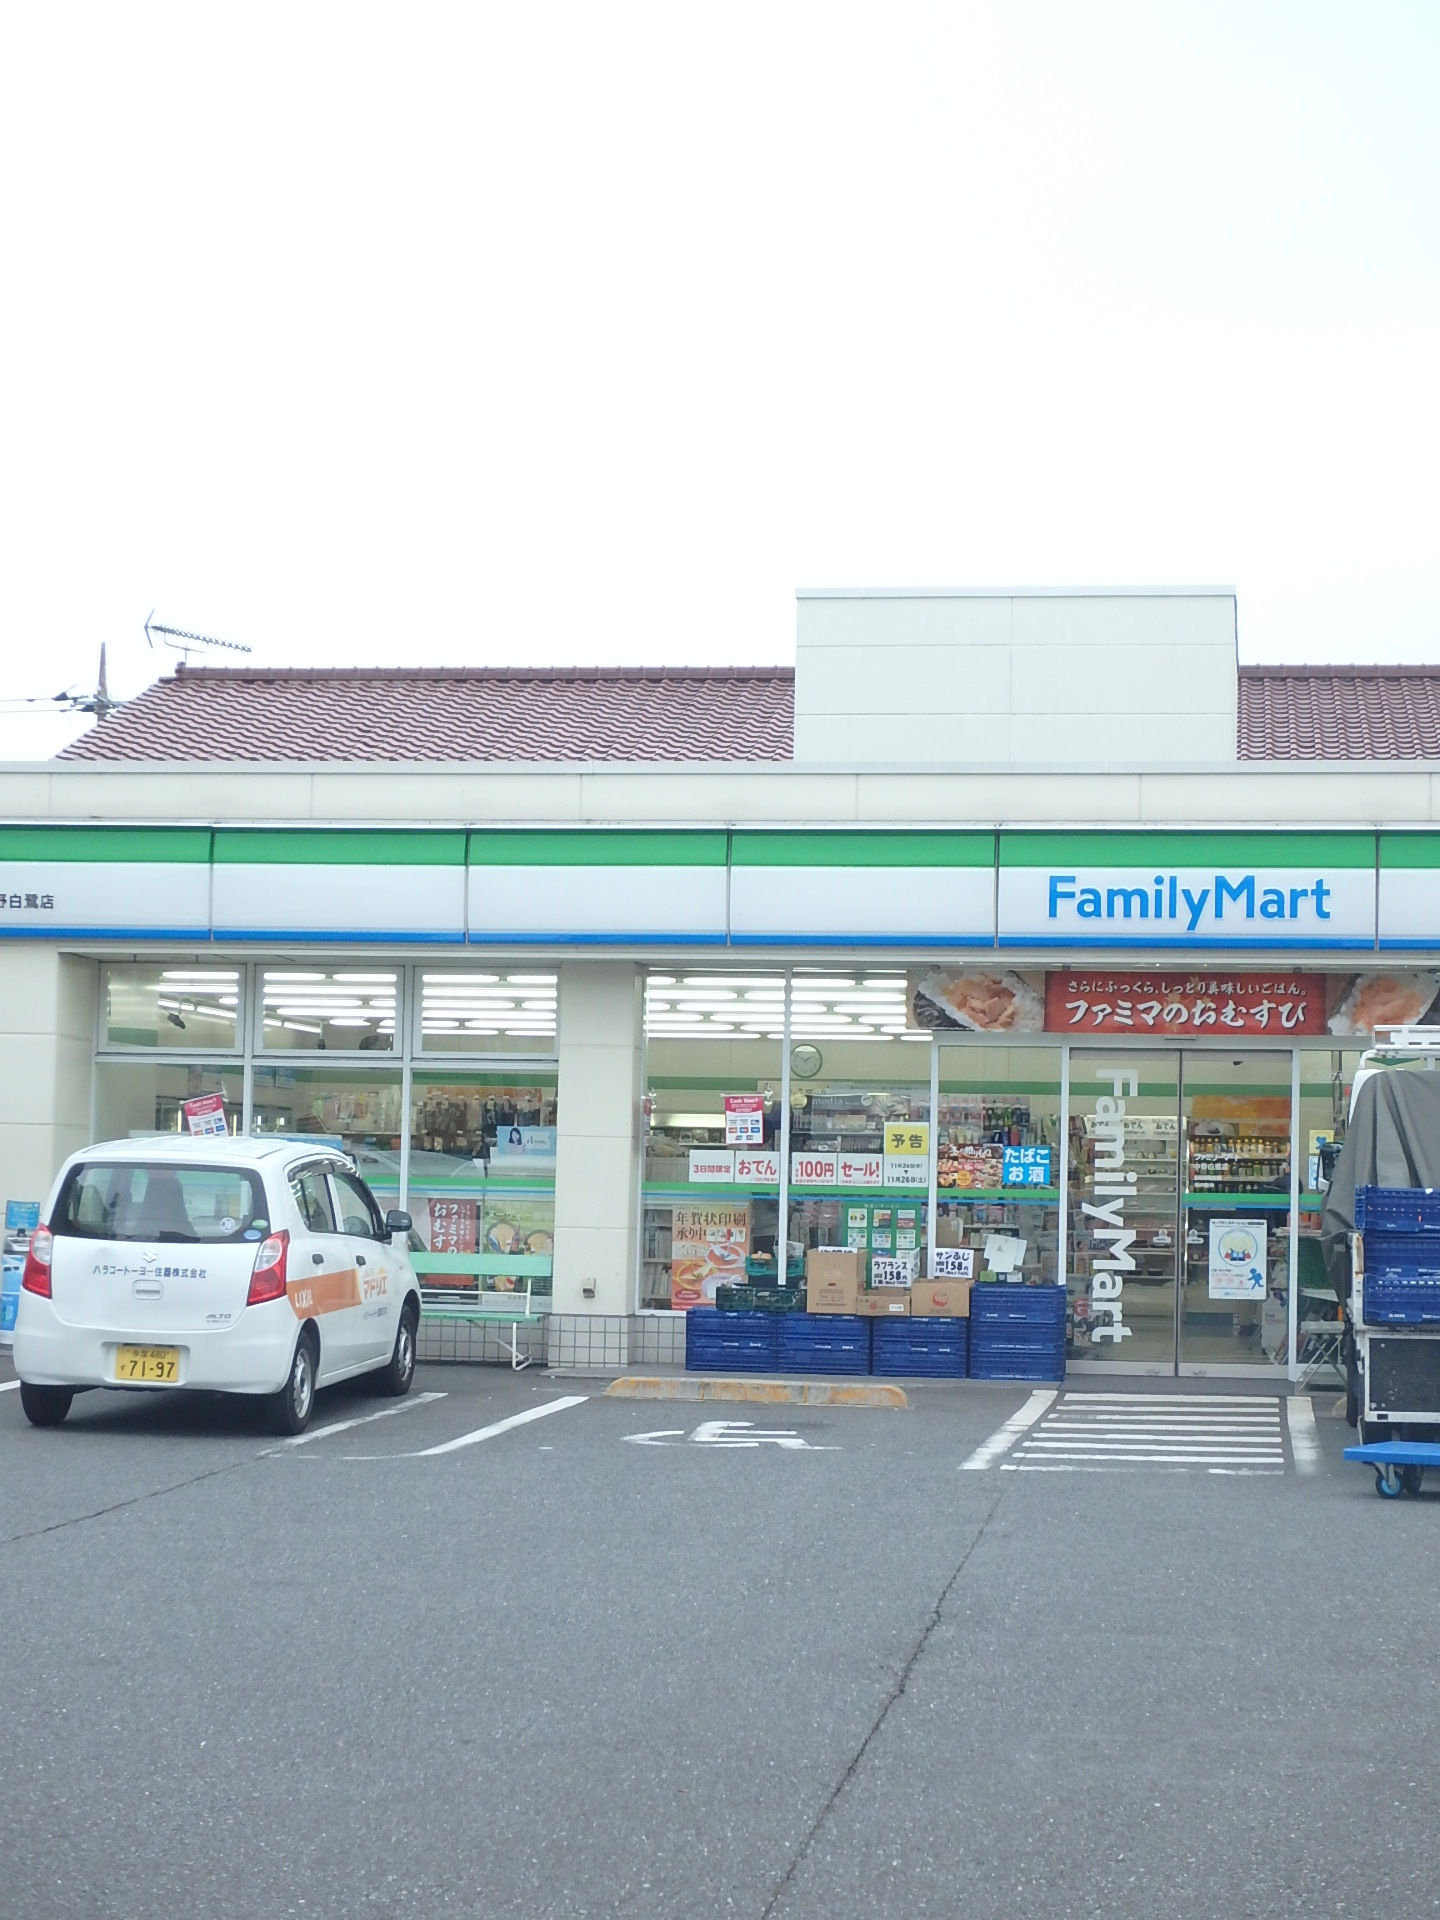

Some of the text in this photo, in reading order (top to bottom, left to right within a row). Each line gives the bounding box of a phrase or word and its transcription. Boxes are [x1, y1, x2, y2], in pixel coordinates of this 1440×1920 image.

[1049, 874, 1331, 931] FamilyMart
[1068, 980, 1306, 996] さらにふっくら、しっとり美味しいごはん。
[1065, 999, 1306, 1029] ファミマのおむすび
[891, 1134, 923, 1149] 予告
[1004, 1147, 1050, 1164] たばこ
[693, 1164, 732, 1174] 3日間限定
[737, 1159, 777, 1176] おでん
[799, 1161, 834, 1178] 100円
[841, 1161, 880, 1178] セール!
[1008, 1166, 1045, 1183] お酒
[1081, 1068, 1139, 1343] FamilyMart
[675, 1212, 747, 1226] 年賀状印刷
[936, 1251, 970, 1261] サンふじ
[874, 1261, 908, 1270] ラフランス
[294, 1289, 314, 1308] LIXIL
[129, 1360, 175, 1378] 71-97
